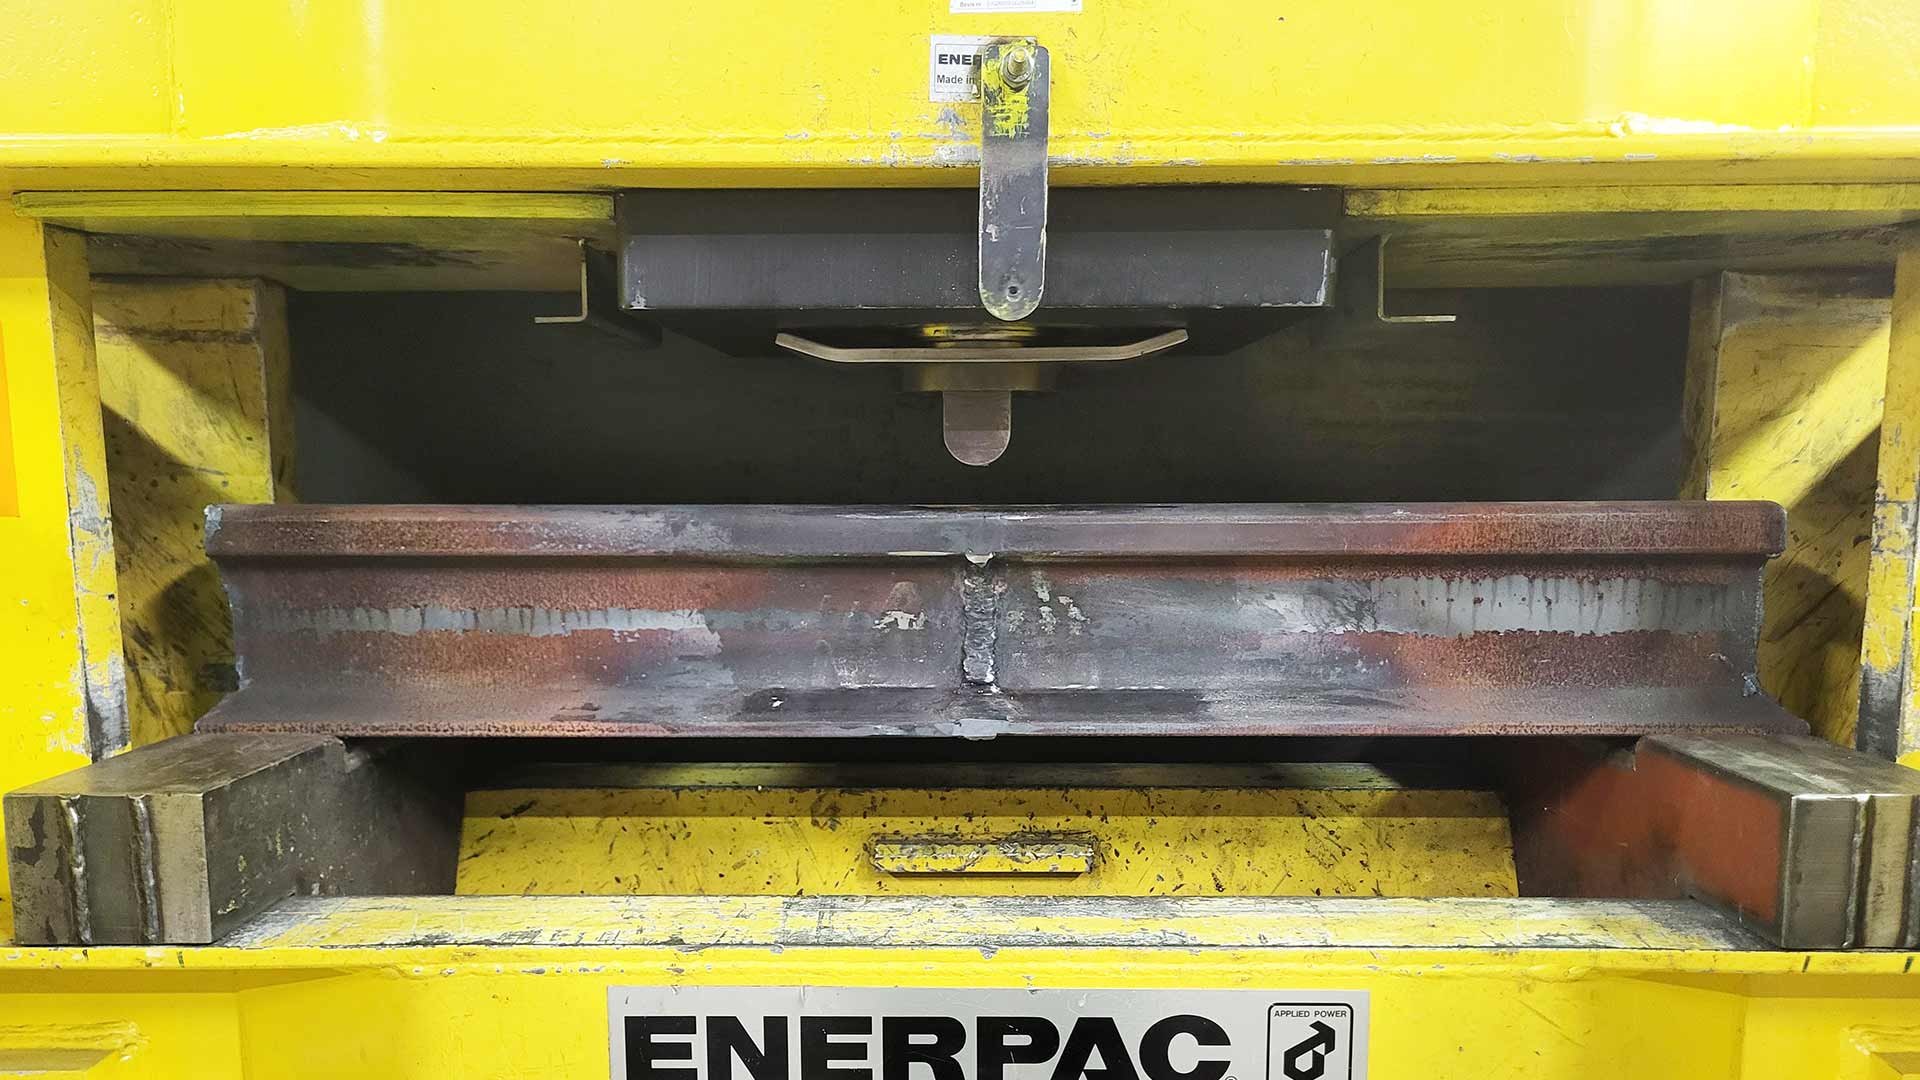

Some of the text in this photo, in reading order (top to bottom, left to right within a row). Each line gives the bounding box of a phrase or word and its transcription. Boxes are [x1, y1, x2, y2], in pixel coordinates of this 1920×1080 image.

[937, 74, 975, 84] Made in
[1274, 1010, 1347, 1018] APPLIED POWER
[624, 1014, 1231, 1080] ENERPAC
